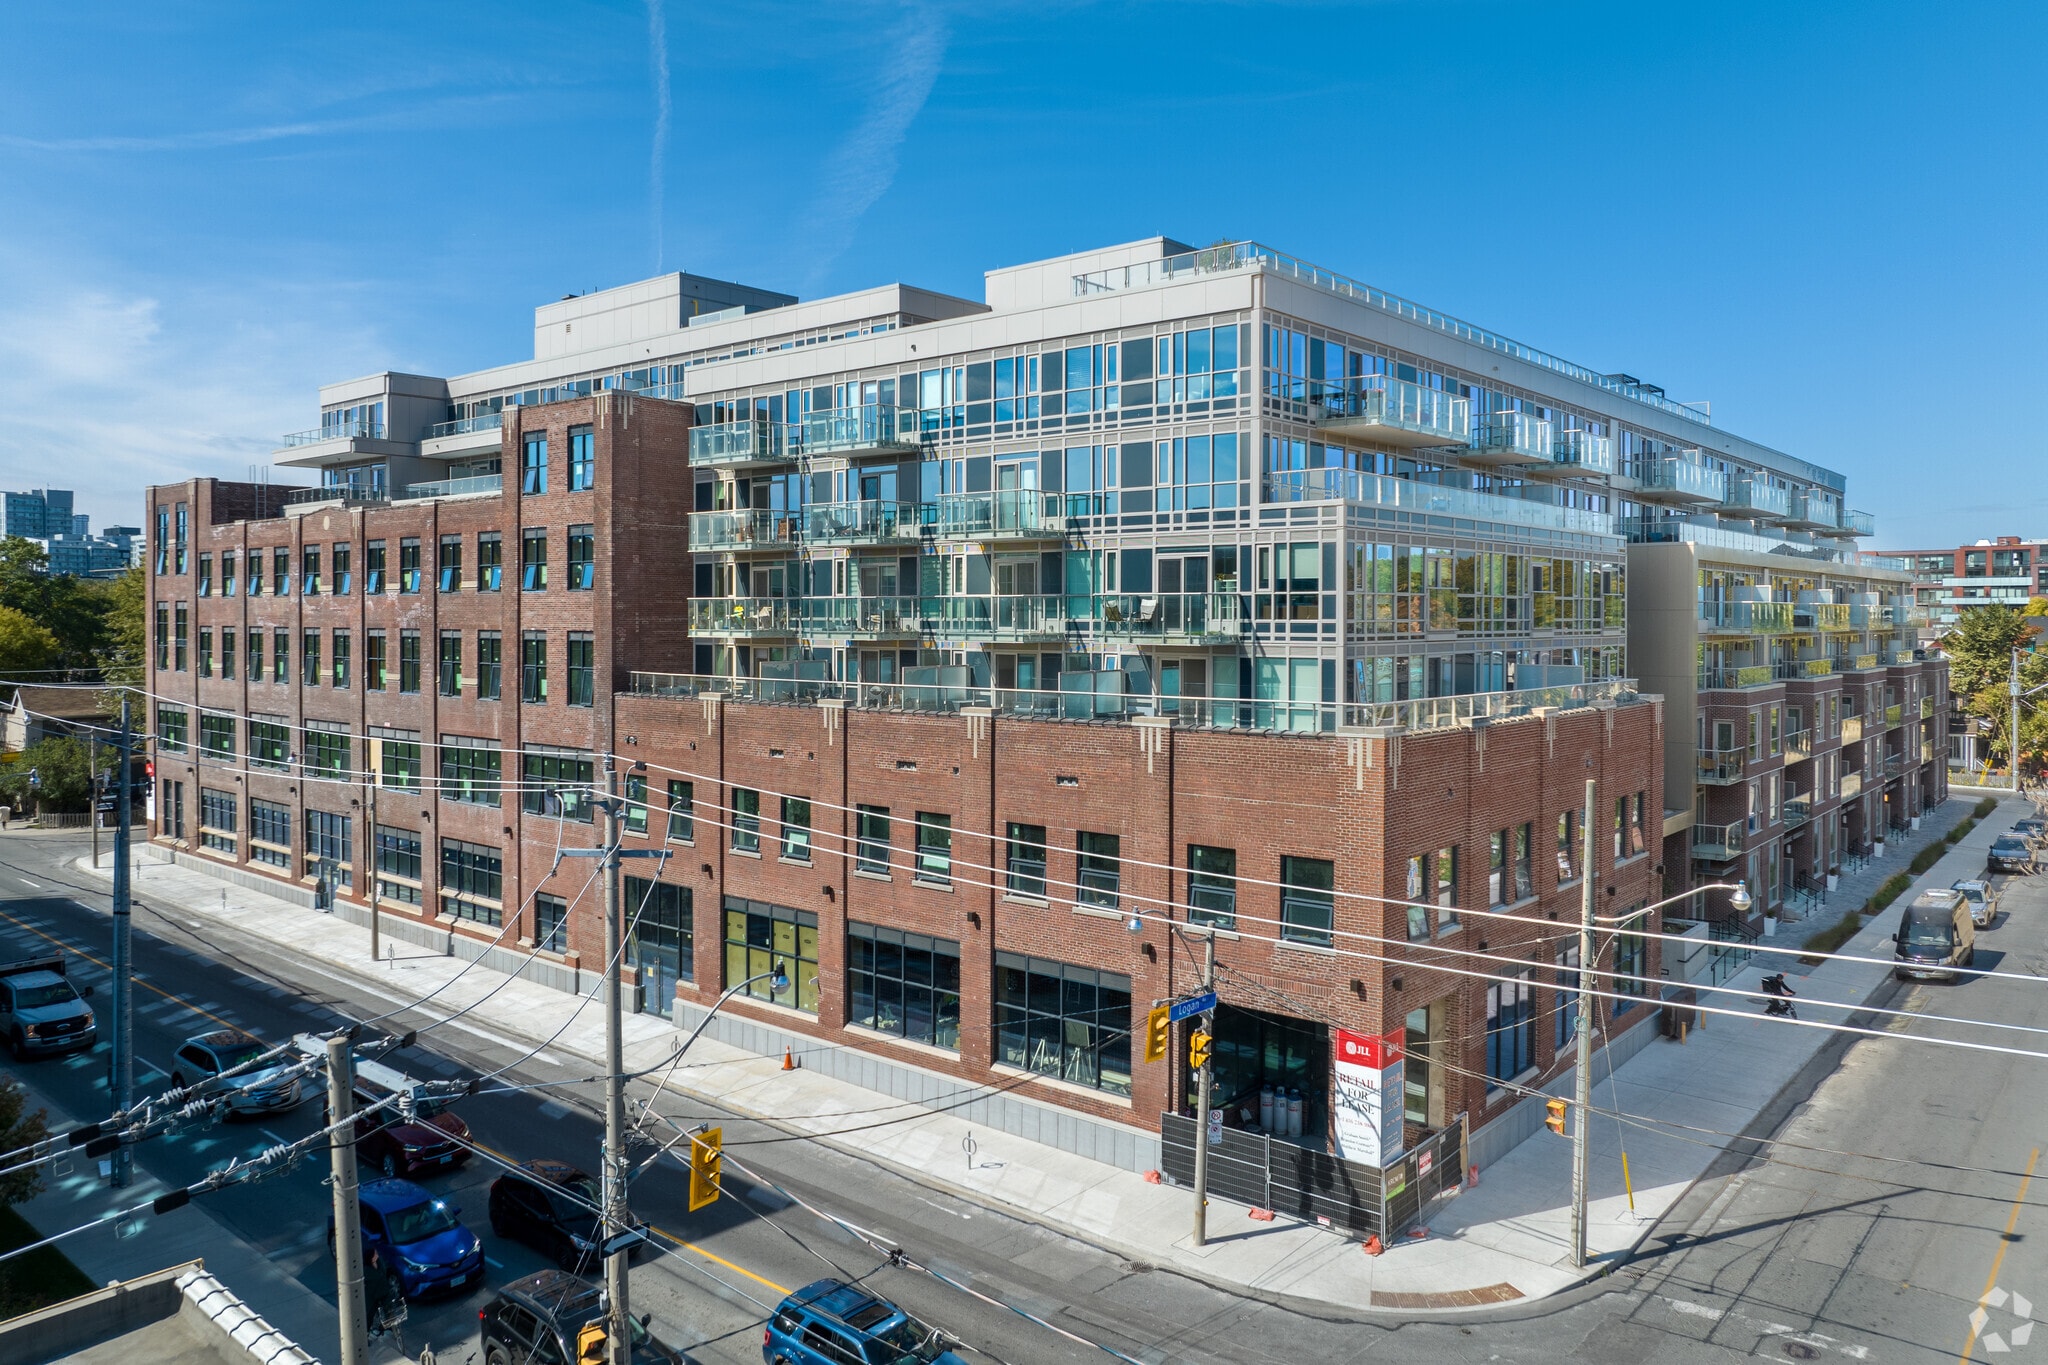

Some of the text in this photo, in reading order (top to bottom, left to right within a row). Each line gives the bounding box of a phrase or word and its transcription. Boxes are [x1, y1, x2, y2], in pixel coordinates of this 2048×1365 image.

[1178, 1001, 1199, 1015] Logan
[1356, 1045, 1371, 1057] JLL
[1339, 1073, 1377, 1090] RETAIL
[1347, 1087, 1368, 1100] FOR
[1341, 1098, 1375, 1115] LEASE
